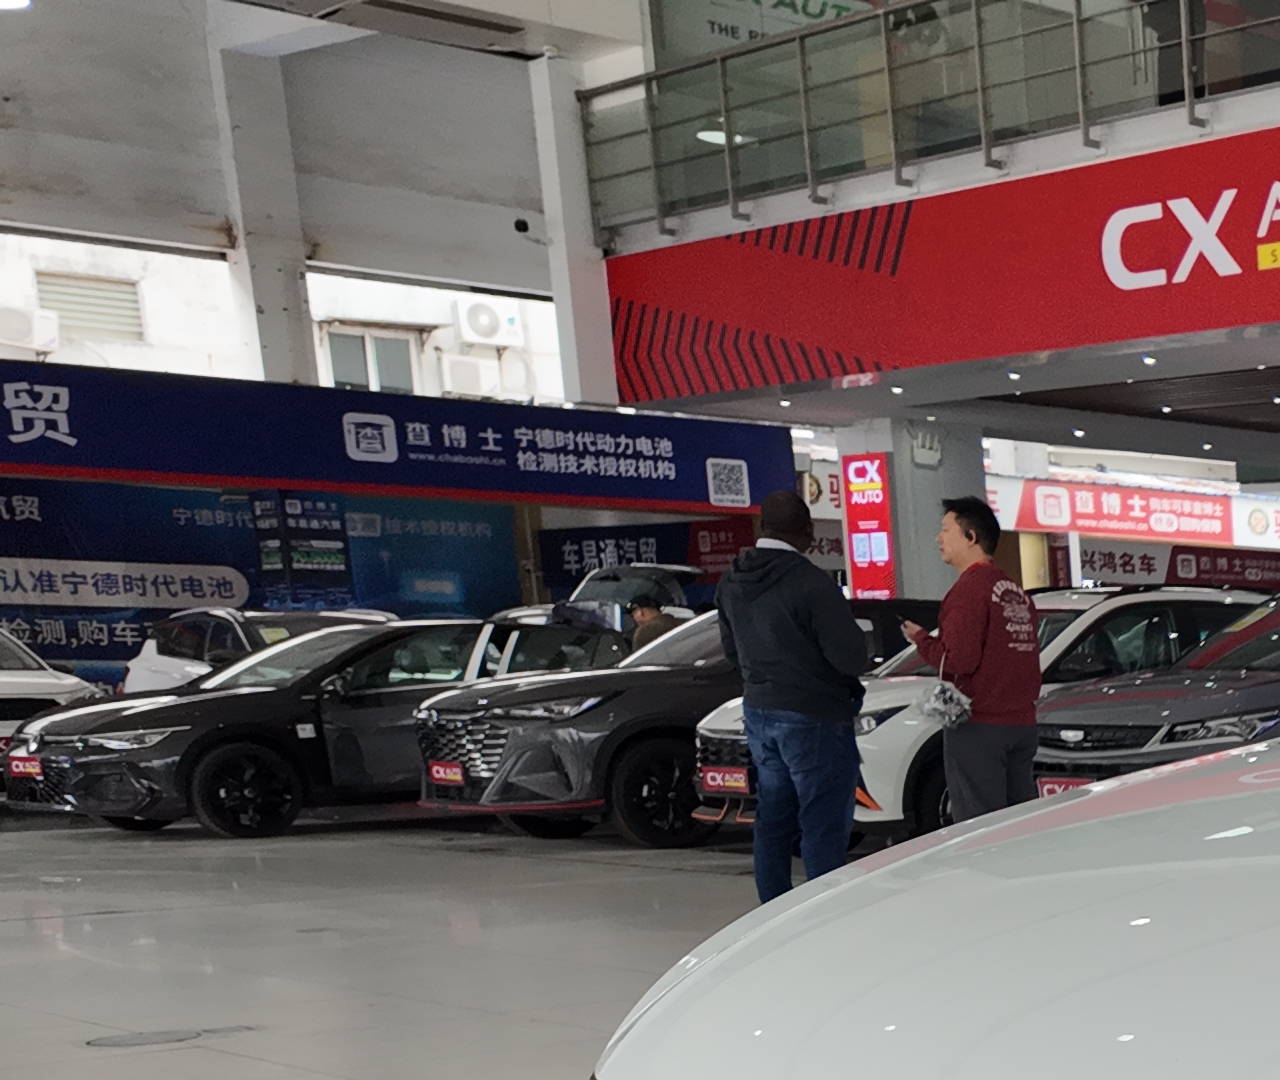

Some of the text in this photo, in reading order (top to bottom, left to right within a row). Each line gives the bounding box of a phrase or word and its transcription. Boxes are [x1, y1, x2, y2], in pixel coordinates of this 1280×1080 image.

[707, 20, 741, 40] THE
[1101, 187, 1244, 291] CX
[3, 381, 79, 448] 贸
[512, 426, 675, 458] 宁德时代动力电池
[516, 450, 677, 481] 检测技术授权机构
[848, 459, 882, 484] CX
[851, 490, 883, 505] AUTO
[706, 770, 724, 788] CX
